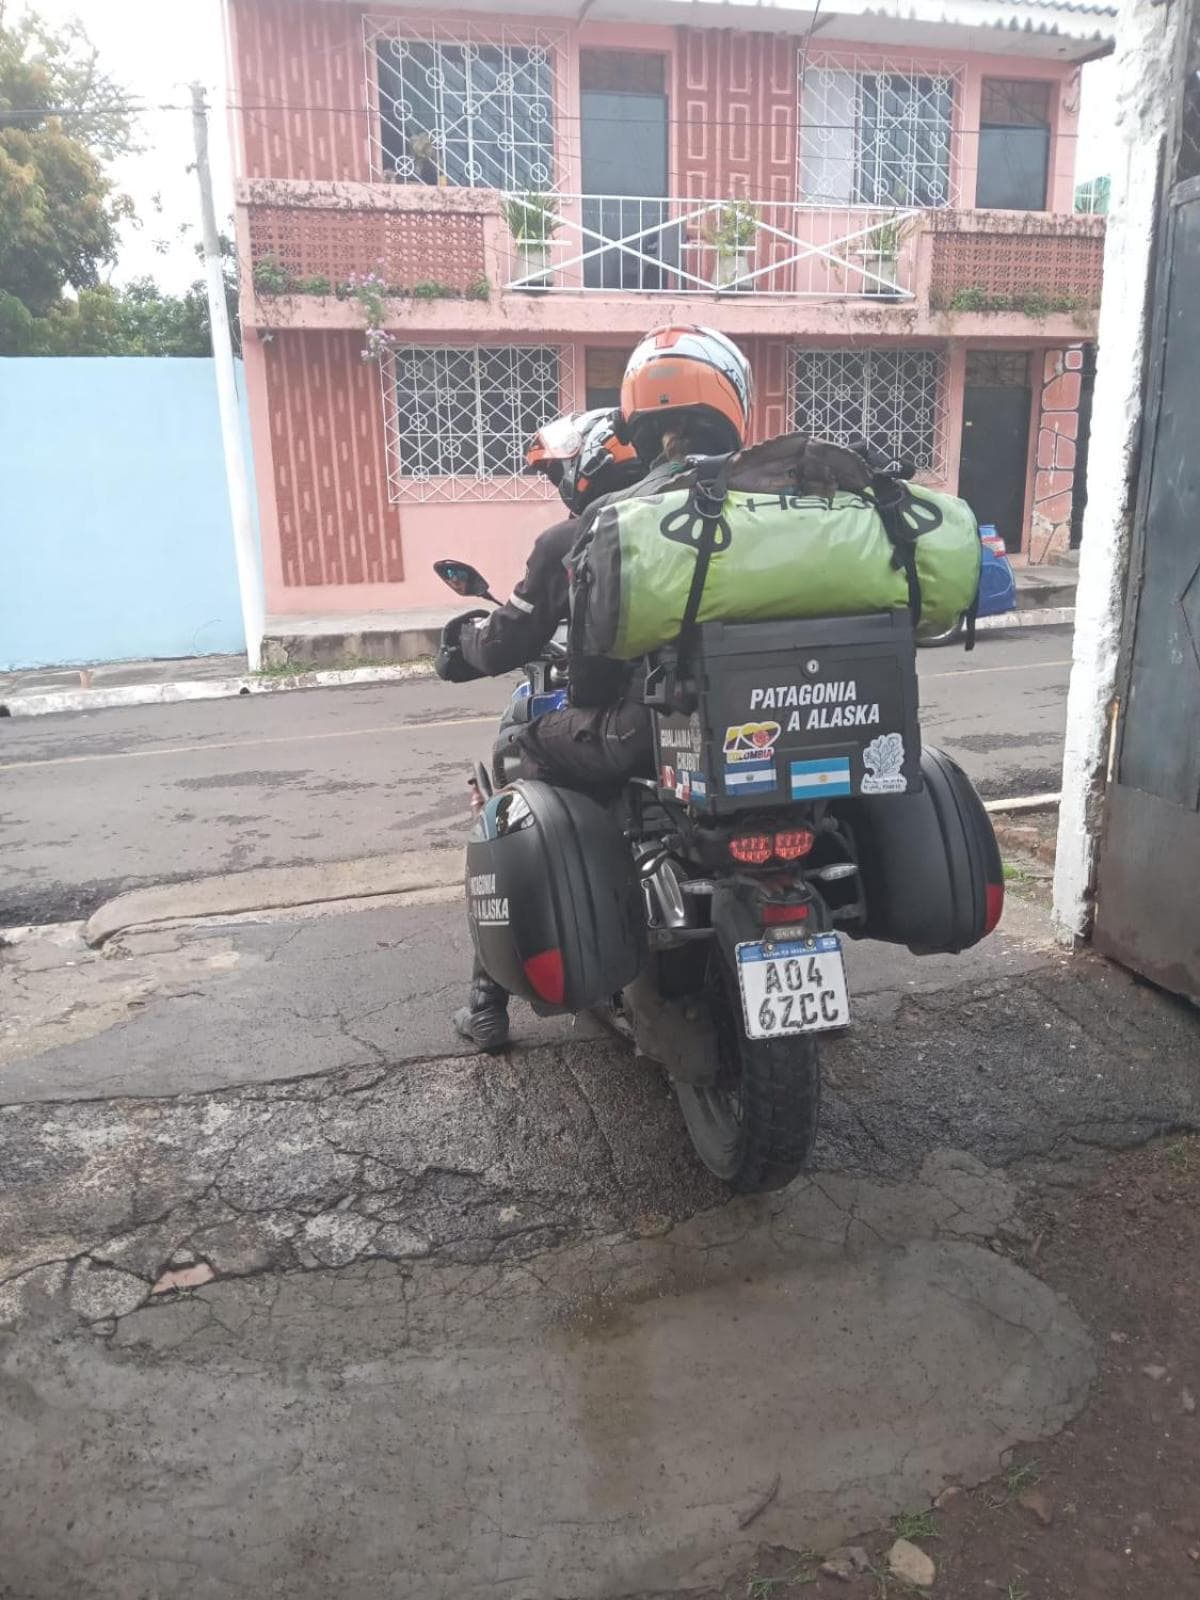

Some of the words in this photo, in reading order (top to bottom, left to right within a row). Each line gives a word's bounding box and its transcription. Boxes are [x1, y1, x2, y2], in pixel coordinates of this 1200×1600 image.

[750, 680, 857, 710] PATAGONIA
[787, 710, 801, 732] A
[806, 703, 880, 730] ALASKA
[765, 957, 823, 995] A04
[758, 990, 840, 1031] 6ZCC
